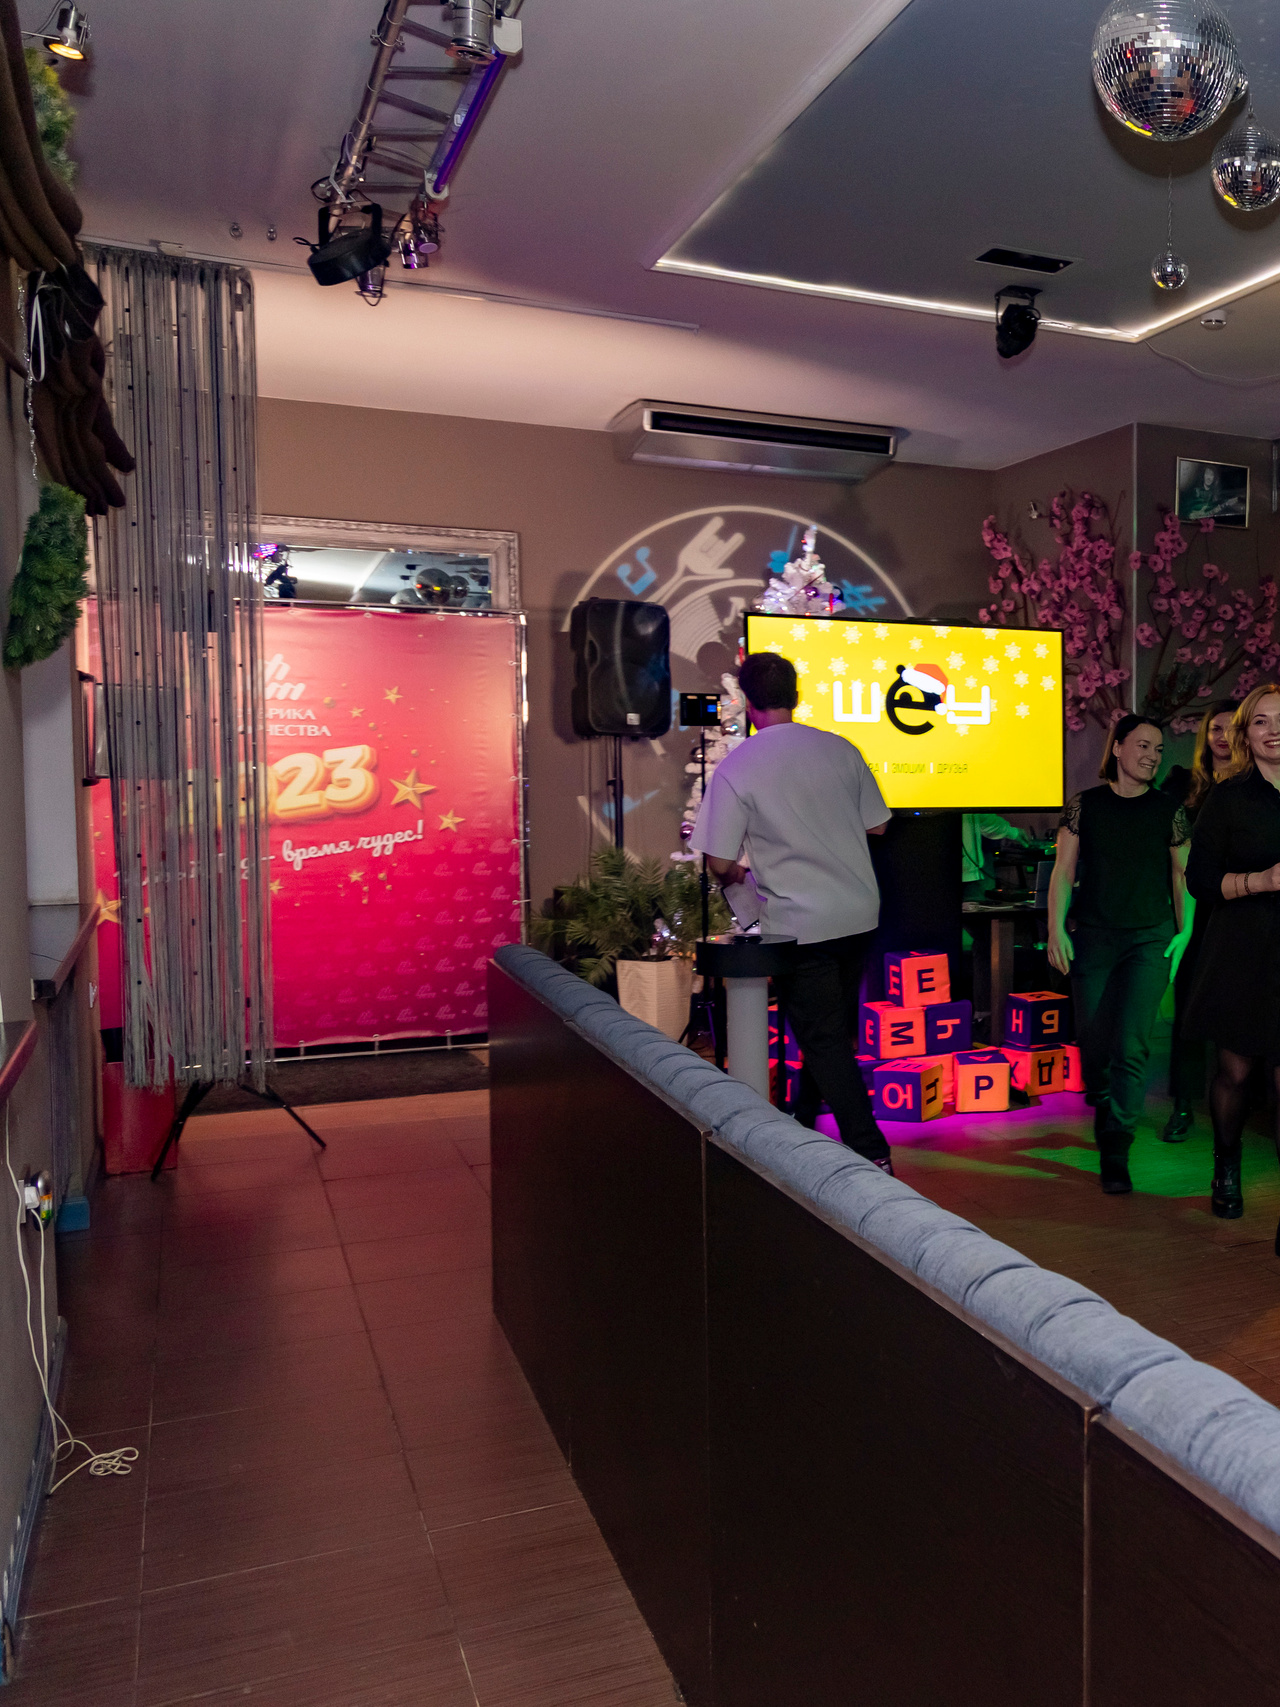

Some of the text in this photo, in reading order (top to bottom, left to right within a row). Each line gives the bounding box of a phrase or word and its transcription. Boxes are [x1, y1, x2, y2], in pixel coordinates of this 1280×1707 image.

[282, 838, 354, 871] время
[356, 819, 425, 857] чудес!
[917, 967, 936, 994] Е
[1011, 1008, 1024, 1034] Н
[974, 1075, 994, 1100] Р
